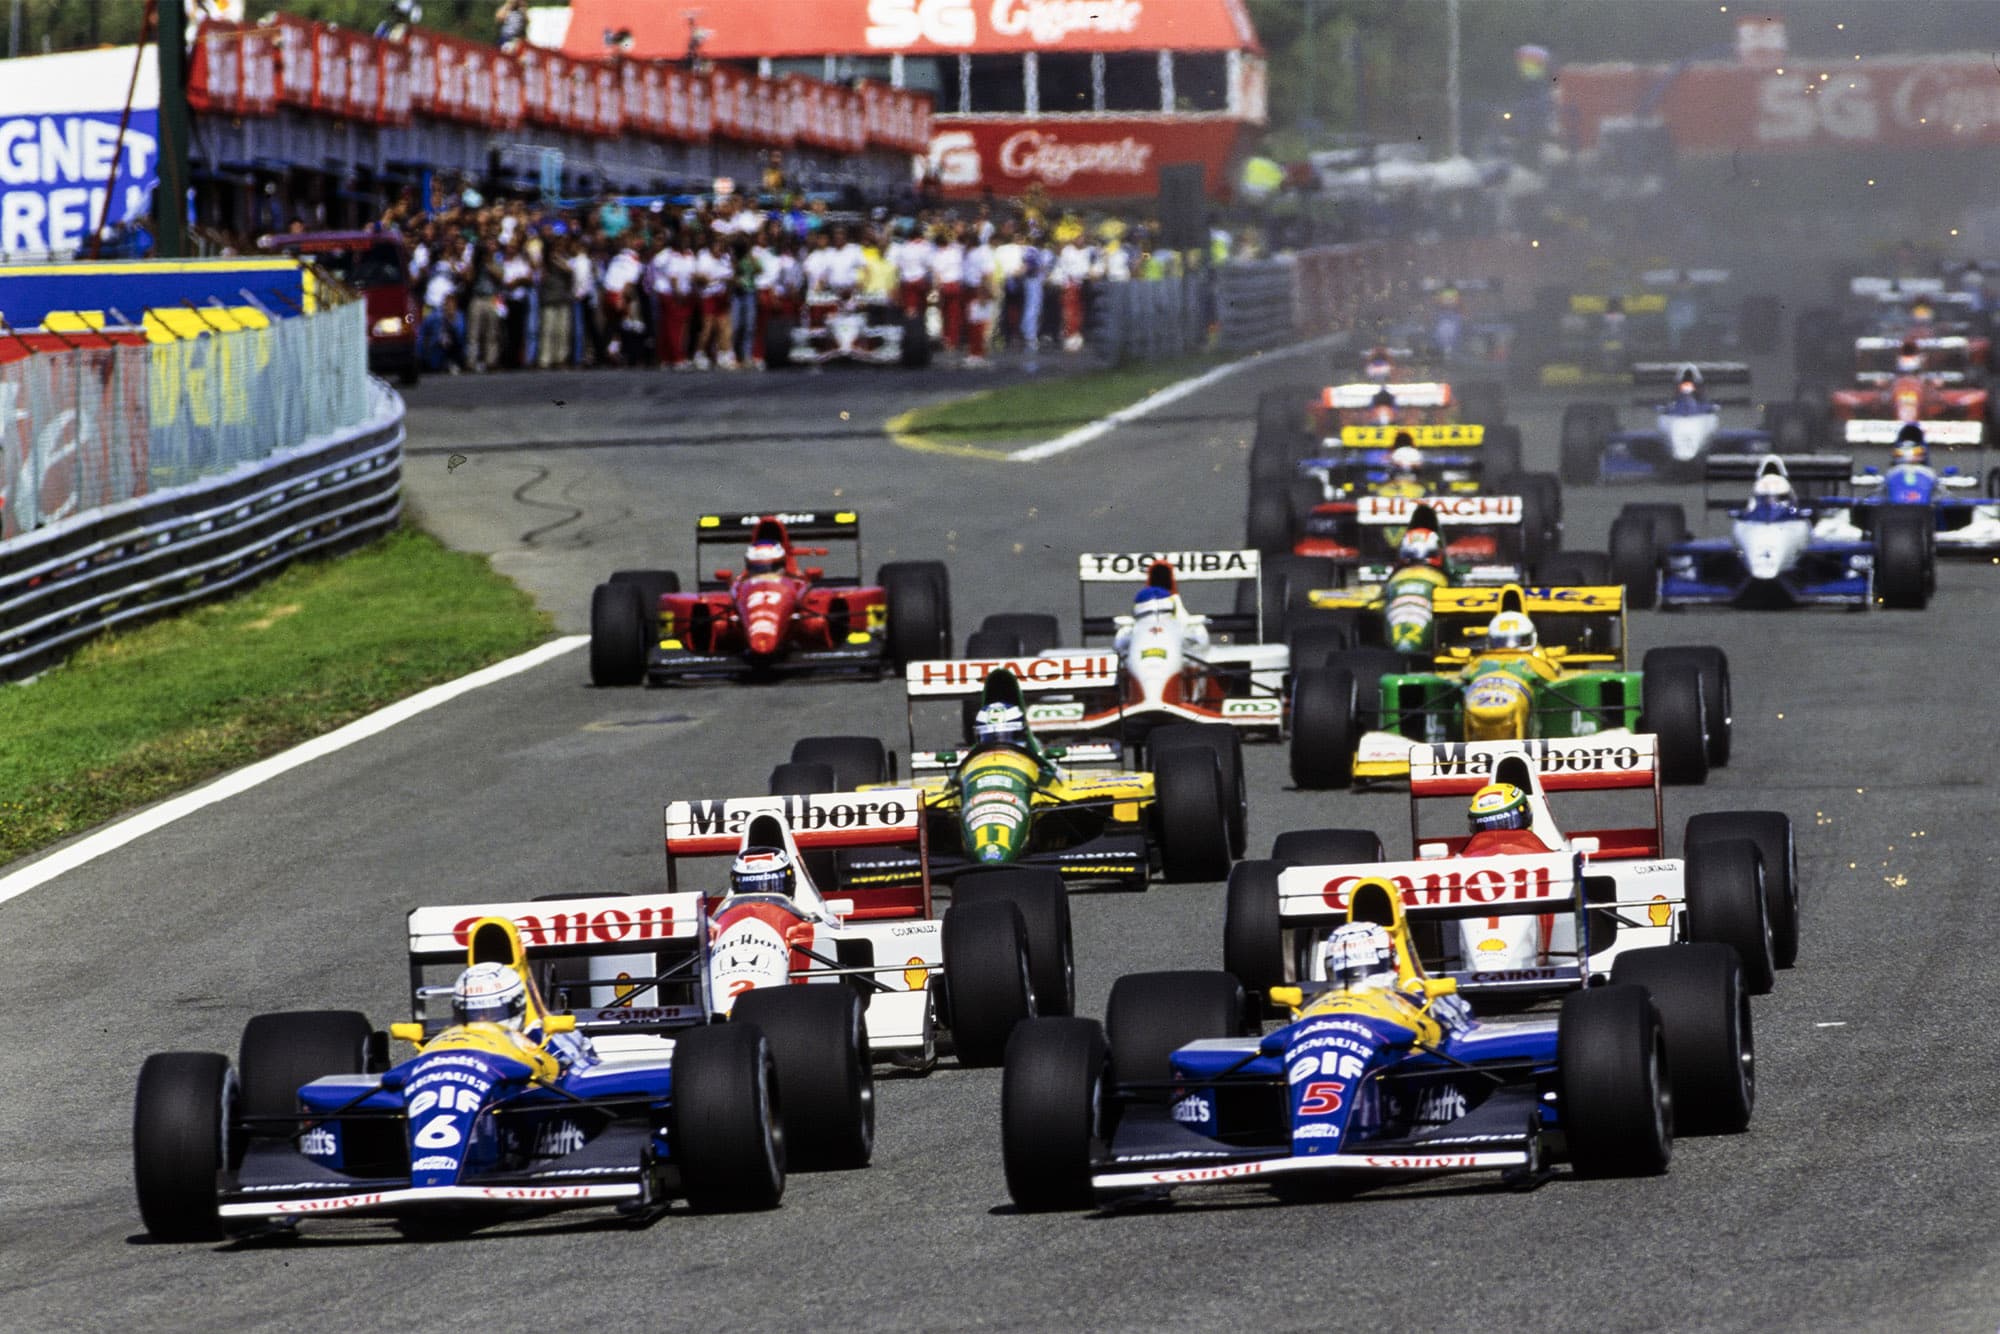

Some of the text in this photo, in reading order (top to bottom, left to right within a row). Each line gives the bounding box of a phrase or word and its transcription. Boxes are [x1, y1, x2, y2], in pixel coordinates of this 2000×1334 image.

[866, 0, 976, 47] SG
[1757, 73, 1879, 139] SG
[1000, 131, 1152, 185] Gigante
[1093, 553, 1247, 573] TOSHIBA
[922, 657, 1108, 686] HITACHI
[1431, 739, 1640, 776] Malboro
[687, 794, 905, 837] Malboro
[974, 825, 1012, 851] 11
[1060, 864, 1135, 875] GOODYEAR
[727, 979, 755, 998] 2
[1471, 969, 1556, 982] Canon
[597, 1006, 681, 1021] Canon
[1284, 1036, 1374, 1063] RENAULT
[404, 1071, 491, 1098] RENAULT
[1288, 1051, 1365, 1086] elf
[408, 1085, 481, 1120] elf
[1297, 1081, 1346, 1116] 5
[414, 1114, 461, 1149] 6
